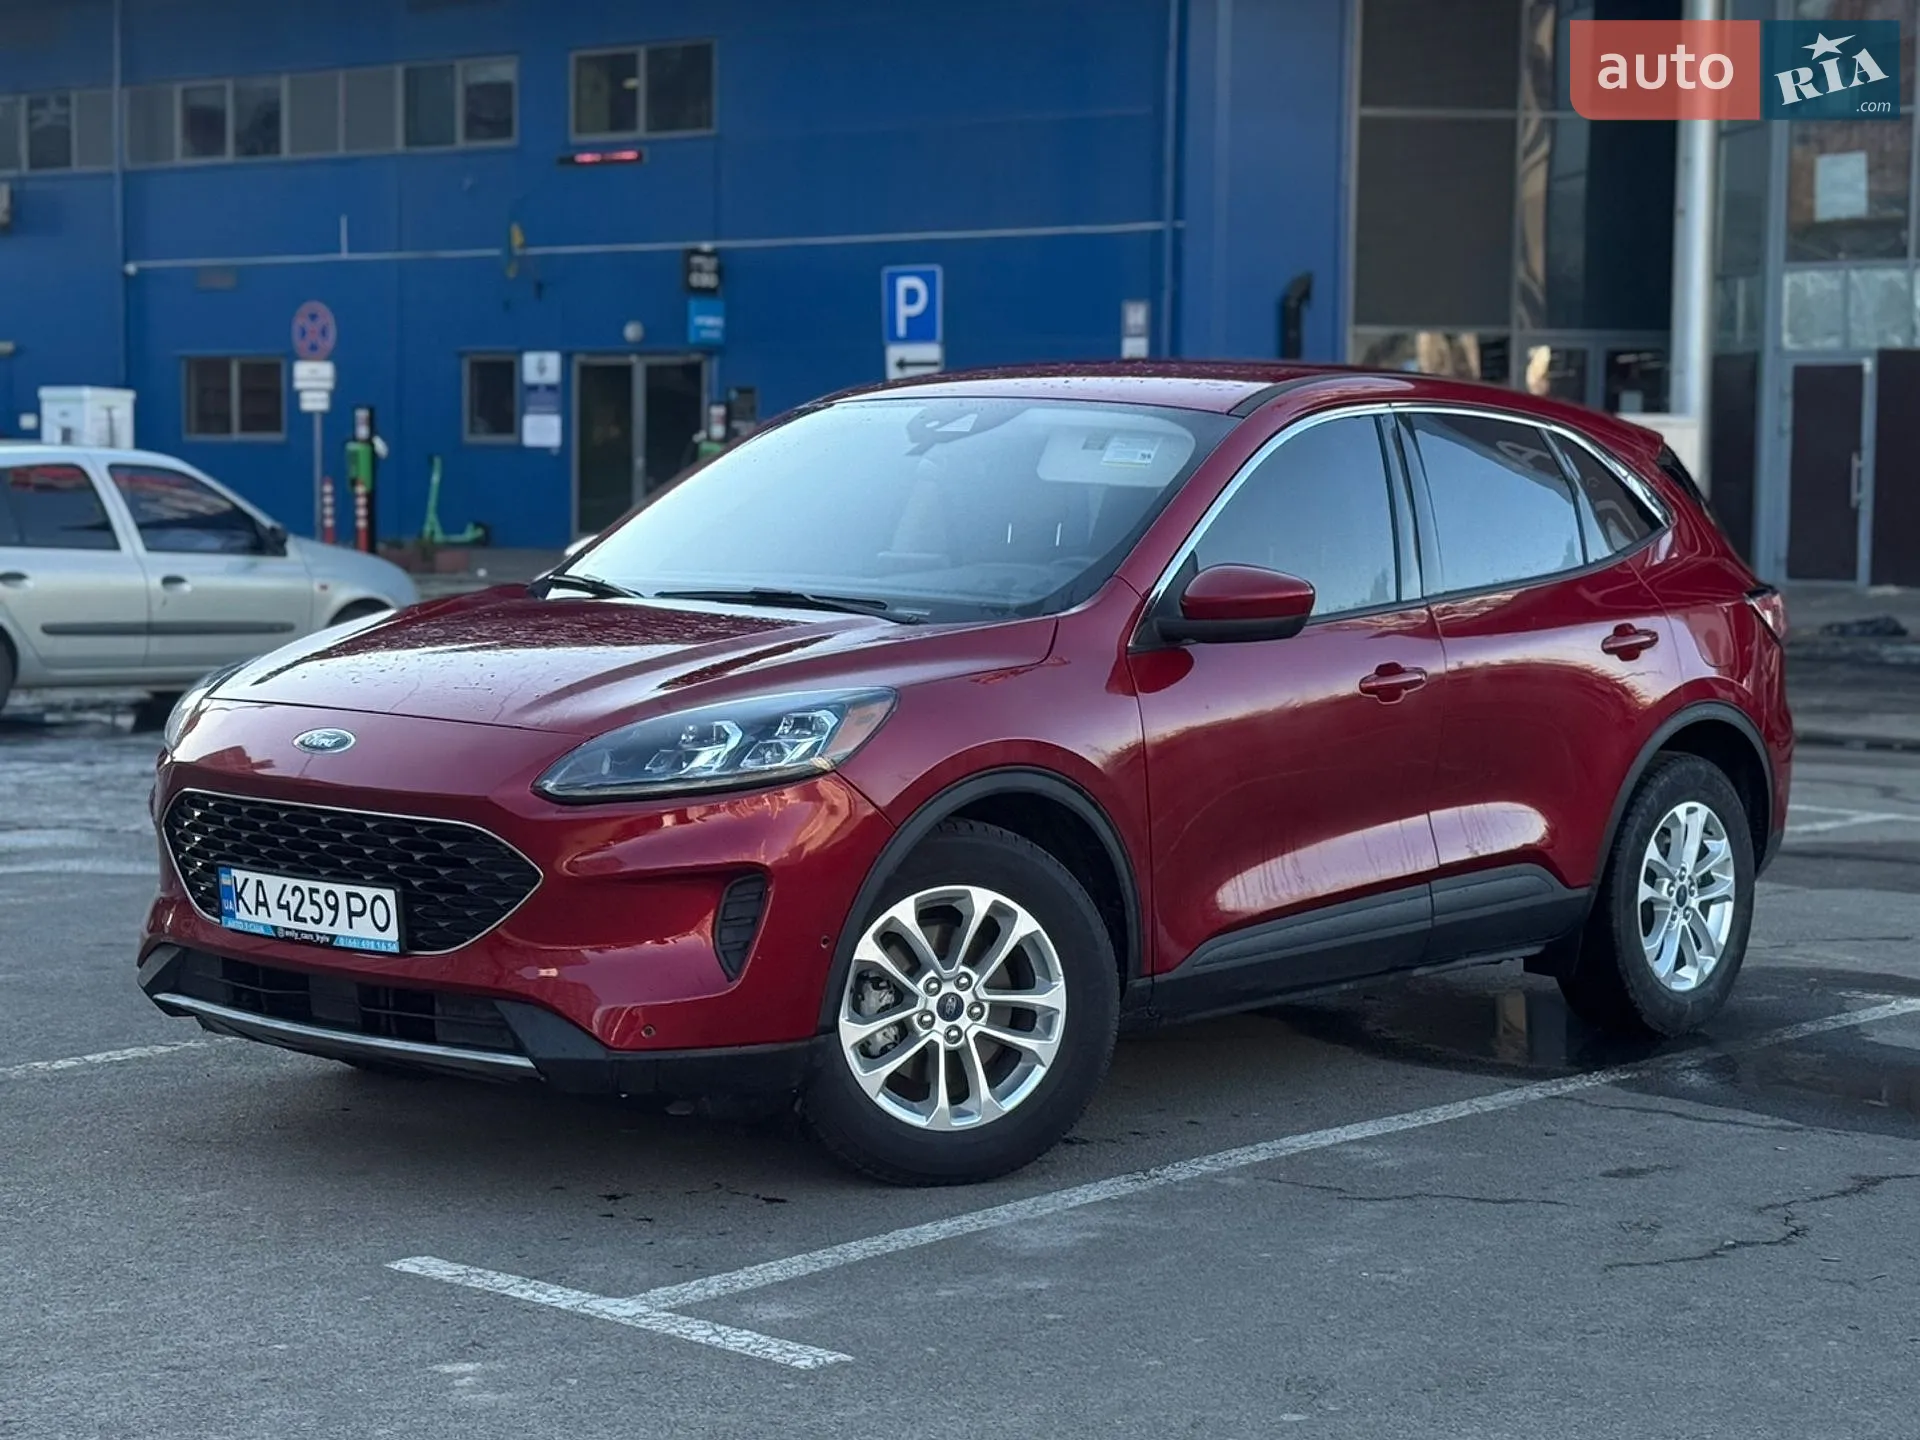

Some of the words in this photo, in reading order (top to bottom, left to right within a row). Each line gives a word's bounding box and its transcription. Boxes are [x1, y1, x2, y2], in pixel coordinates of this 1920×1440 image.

[895, 275, 928, 338] P
[223, 899, 235, 911] UA
[233, 875, 272, 919] KA
[276, 883, 340, 927] 4259
[345, 891, 391, 933] PO
